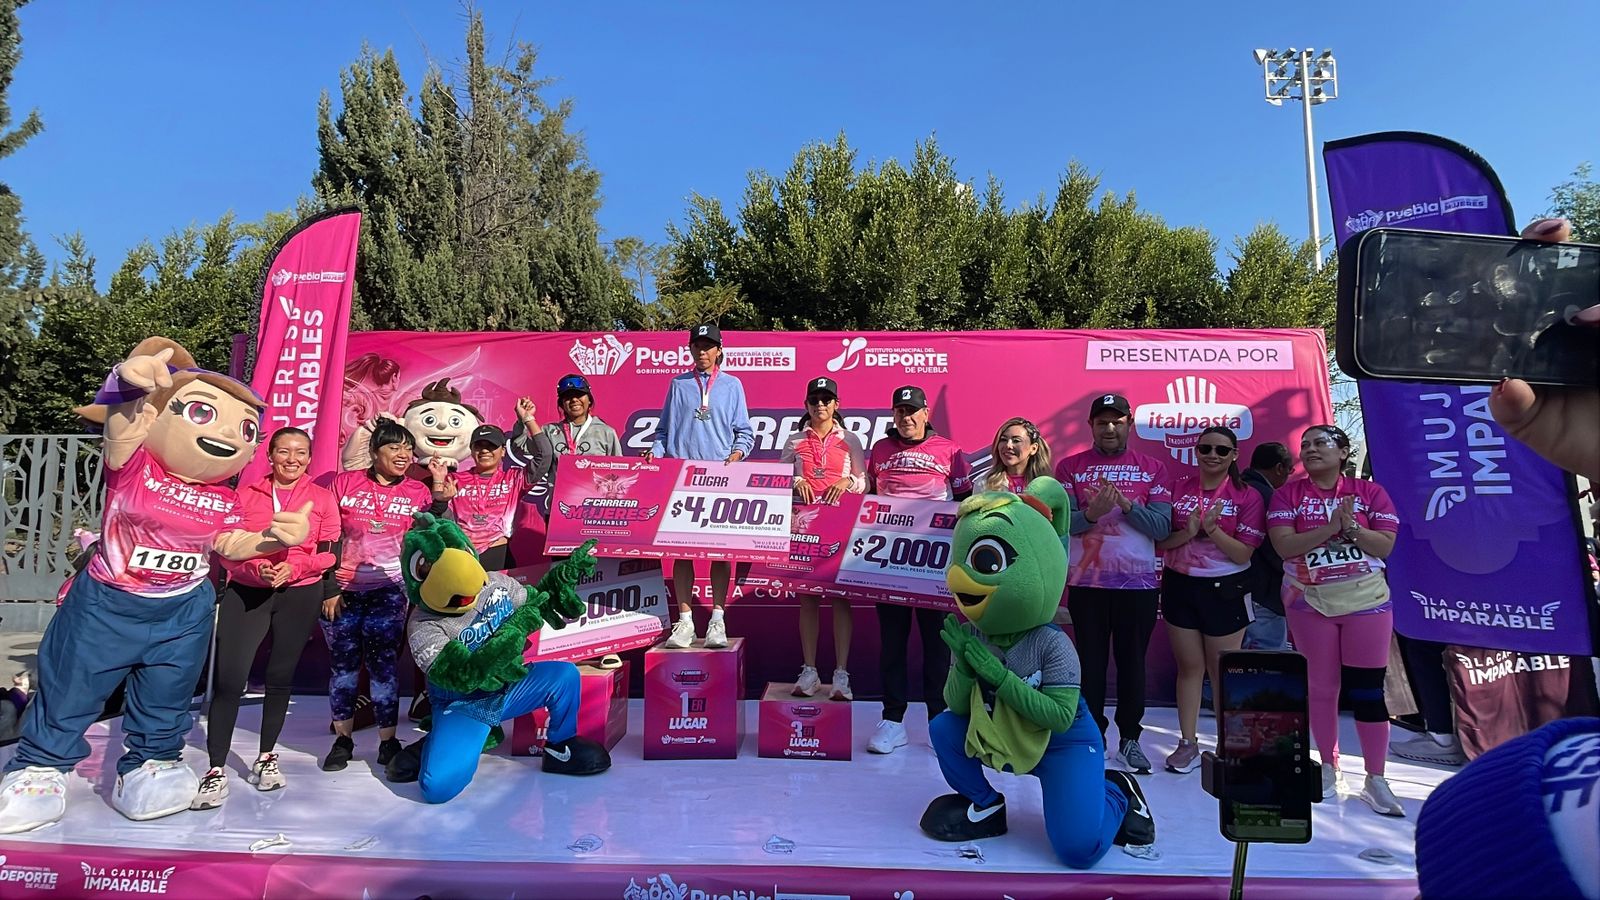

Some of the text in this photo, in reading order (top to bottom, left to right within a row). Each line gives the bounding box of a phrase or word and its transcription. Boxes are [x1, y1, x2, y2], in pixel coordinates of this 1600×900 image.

[1386, 201, 1439, 221] Puebla
[635, 345, 697, 368] Pueb
[725, 356, 791, 368] MUJERES
[864, 353, 949, 367] DEPORTE
[1099, 348, 1278, 362] PRESENTADA POR
[635, 367, 669, 375] GOBIERNO
[905, 366, 949, 374] DE PUEBLA
[1148, 411, 1241, 433] italpasta
[1095, 464, 1140, 472] CARRERA
[691, 475, 730, 487] LUGAR
[771, 476, 791, 488] KM
[593, 499, 638, 509] CARRERA
[568, 506, 649, 521] MUJERES
[876, 512, 915, 527] LUGAR
[583, 519, 628, 527] IMPARABLES
[790, 542, 830, 557] ERES
[135, 550, 198, 572] 1180
[1307, 546, 1363, 569] 2140
[1430, 597, 1540, 615] LA CAPITAL
[1424, 606, 1556, 630] IMPARABLE
[1474, 657, 1494, 668] LA
[669, 717, 708, 730] LUGAR
[789, 738, 820, 747] LUGAR
[0, 870, 58, 884] DEPORTE
[91, 868, 161, 879] LA CAPITAL
[83, 876, 168, 894] IMPARABLE
